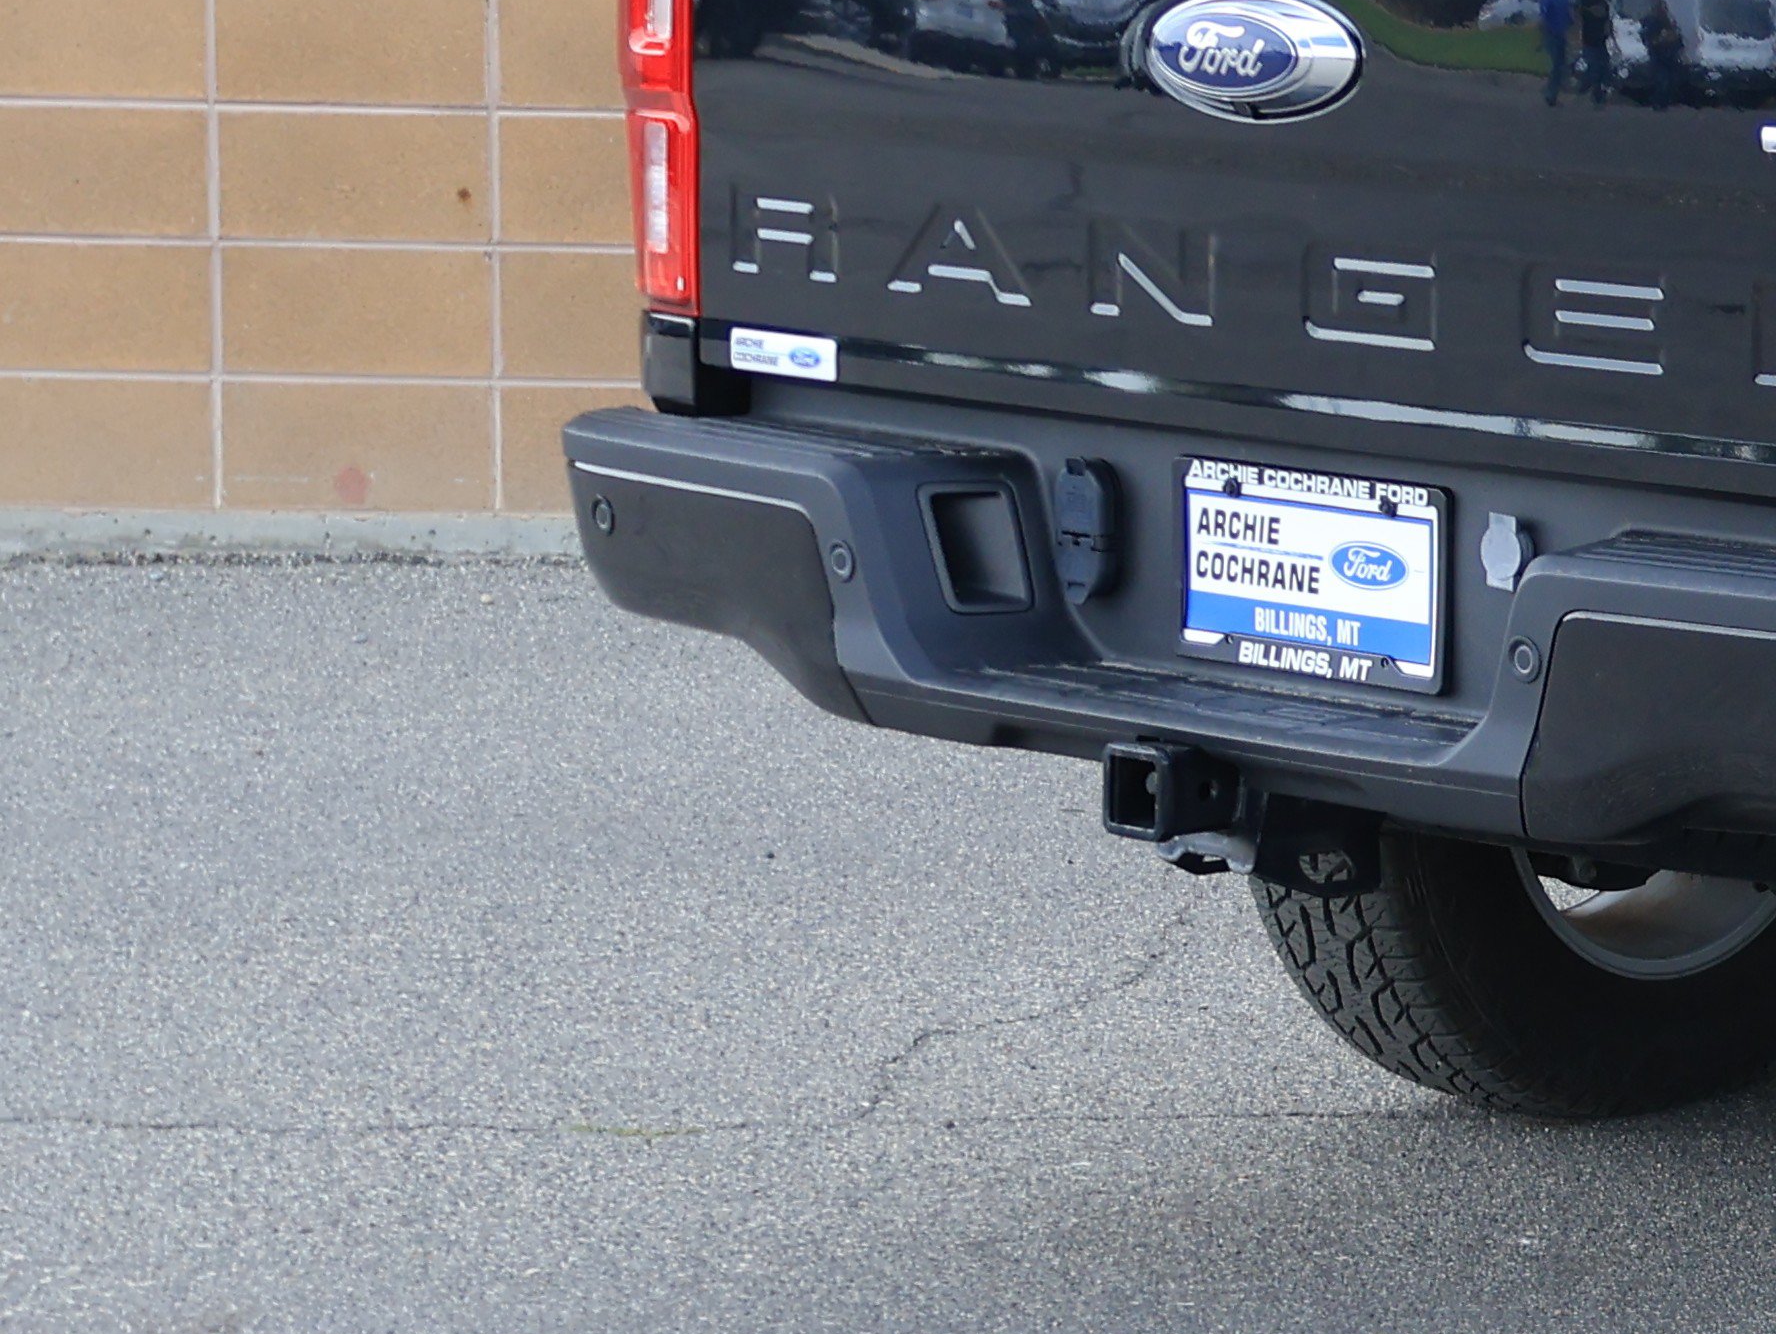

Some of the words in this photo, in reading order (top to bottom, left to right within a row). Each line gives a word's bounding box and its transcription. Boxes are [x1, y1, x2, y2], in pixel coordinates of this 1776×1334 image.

[1178, 20, 1265, 77] Ford
[1188, 459, 1260, 484] ARCHIE
[1263, 468, 1371, 500] COCHRANE
[1375, 485, 1429, 507] FORD
[1196, 506, 1282, 545] ARCHIE
[1195, 550, 1322, 595] COCHRANE
[1343, 546, 1394, 583] Ford
[1253, 606, 1333, 646] BILLINGS,
[1336, 619, 1362, 647] MT
[1238, 641, 1334, 680] BILLINGS,
[1338, 657, 1373, 682] MT
